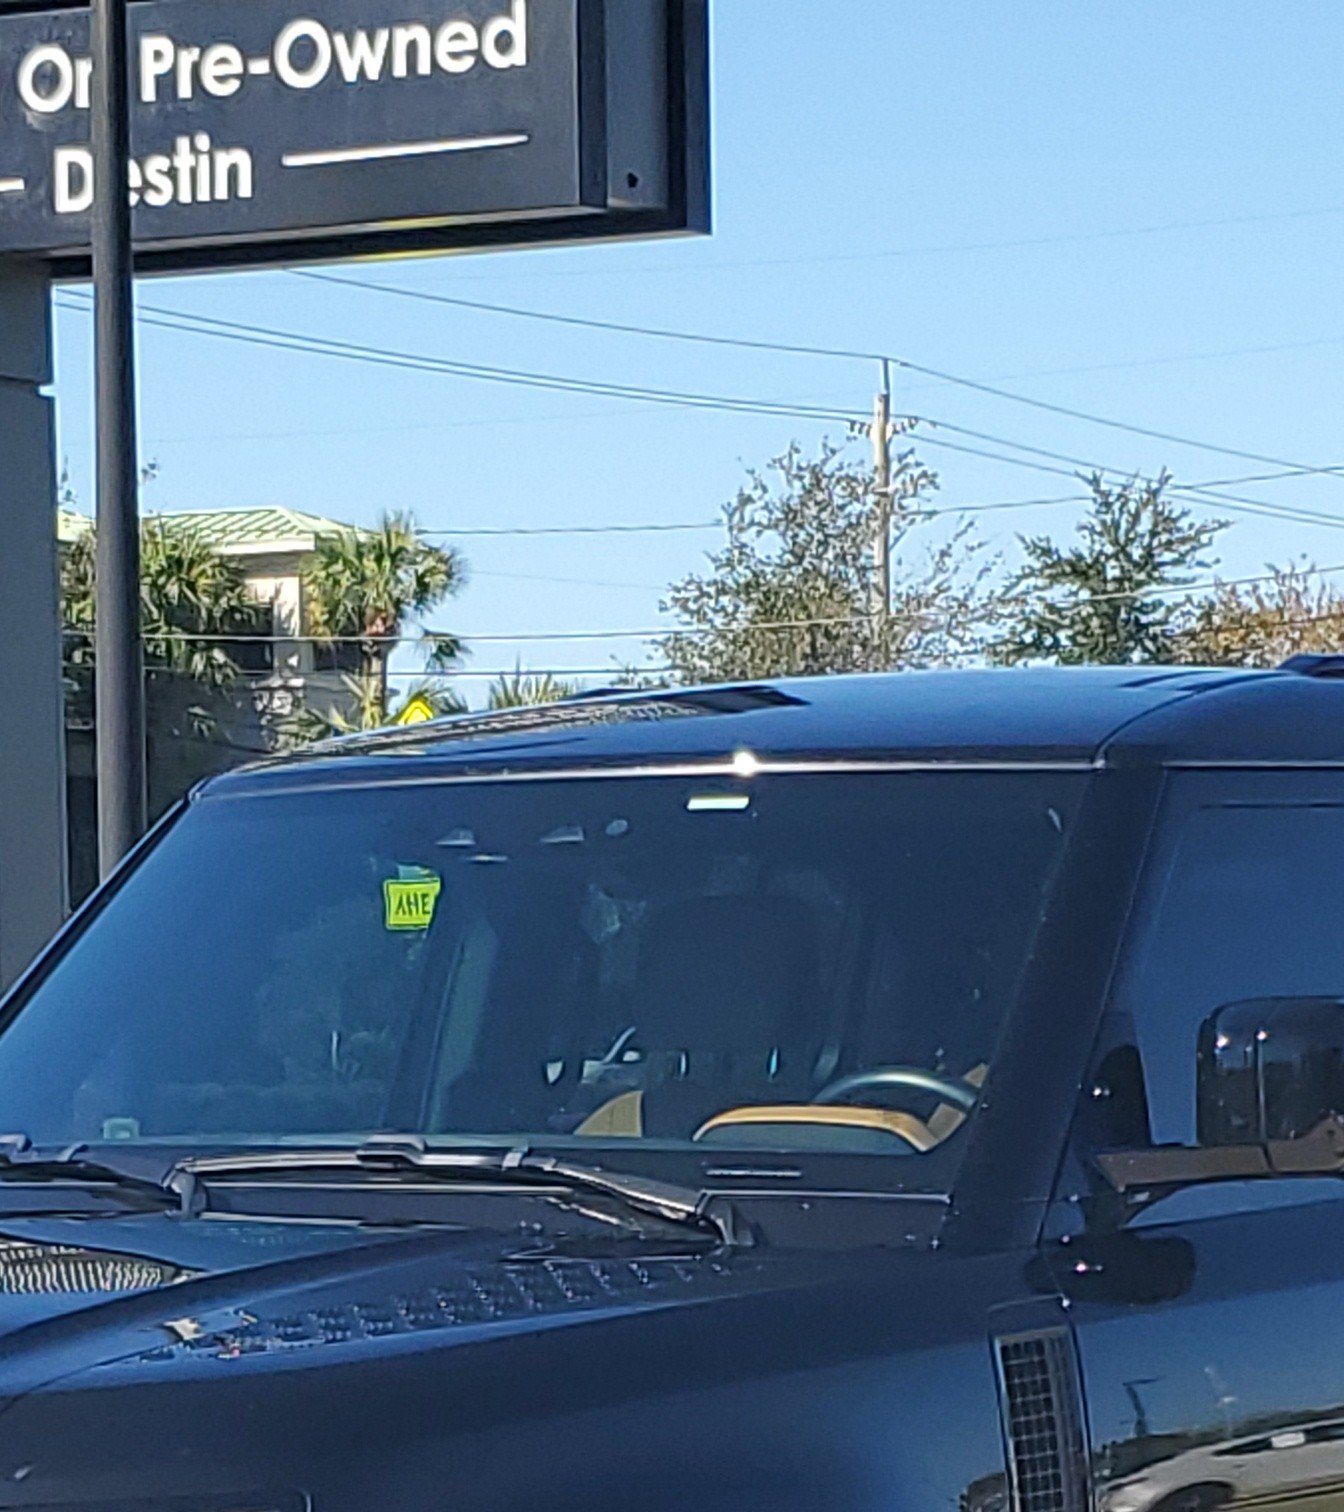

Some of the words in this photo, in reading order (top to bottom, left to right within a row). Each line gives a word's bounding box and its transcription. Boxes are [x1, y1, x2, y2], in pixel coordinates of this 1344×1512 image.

[17, 44, 94, 113] Or
[140, 0, 527, 103] Pre-Owned
[395, 892, 431, 916] AHE
